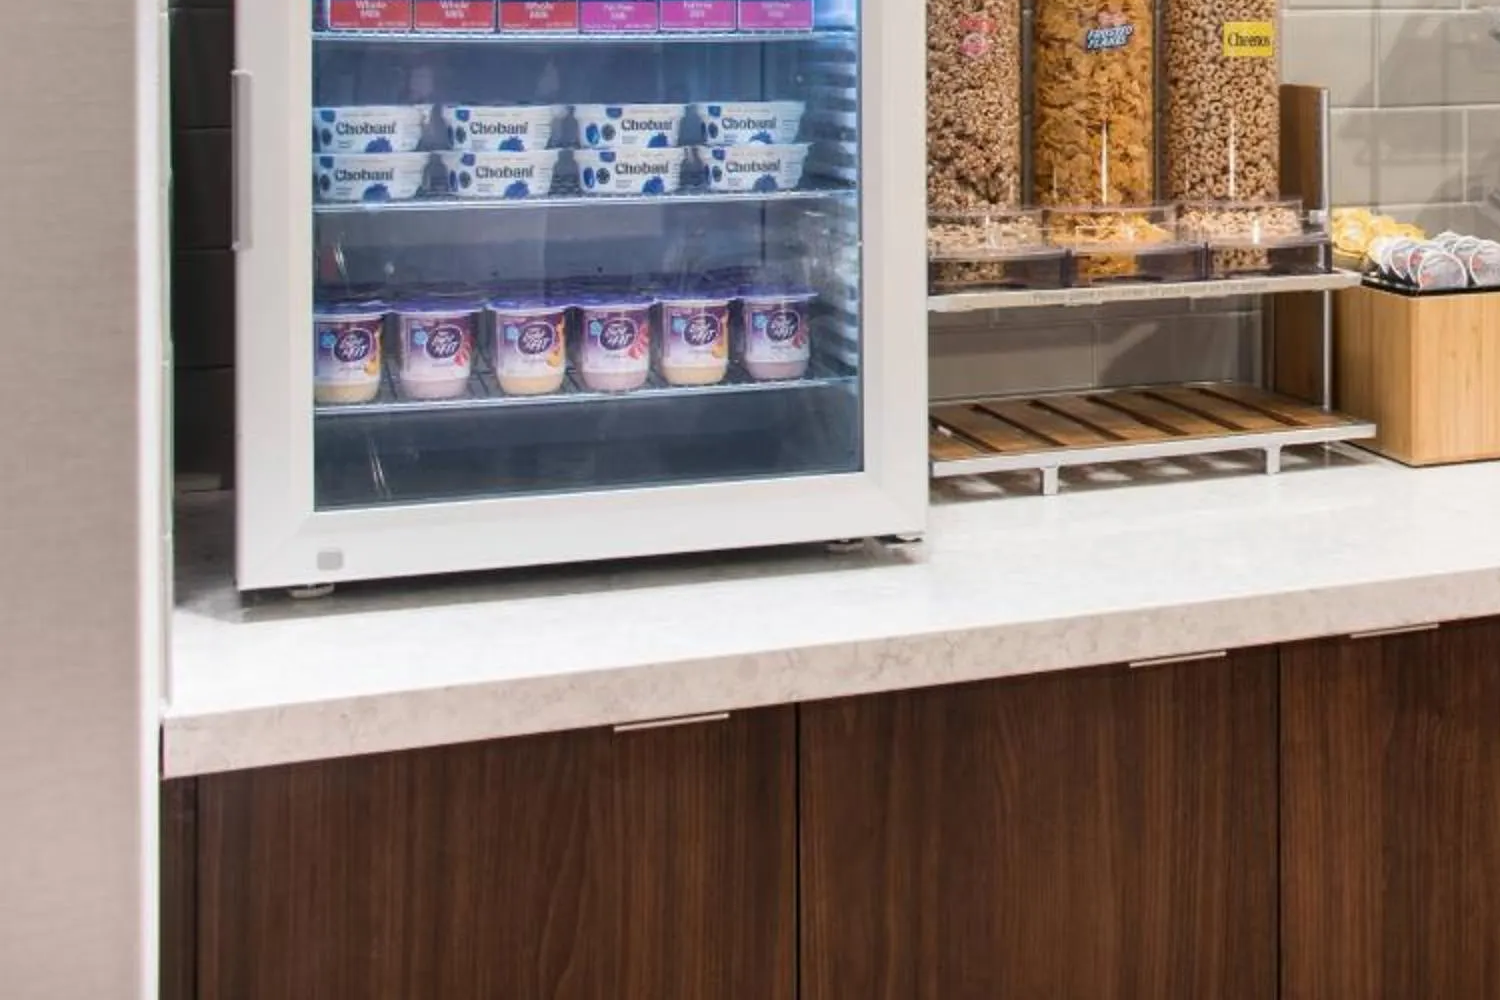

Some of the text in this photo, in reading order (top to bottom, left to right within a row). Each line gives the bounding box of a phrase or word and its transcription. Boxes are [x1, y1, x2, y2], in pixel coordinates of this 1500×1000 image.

[335, 121, 396, 135] Chobani
[469, 121, 529, 135] Chobani
[621, 119, 674, 131] Chobani
[721, 116, 777, 130] Chobani
[475, 165, 535, 179] Chobani
[614, 162, 669, 175] Chobani
[725, 159, 781, 173] Chobani
[334, 168, 395, 182] Chobani
